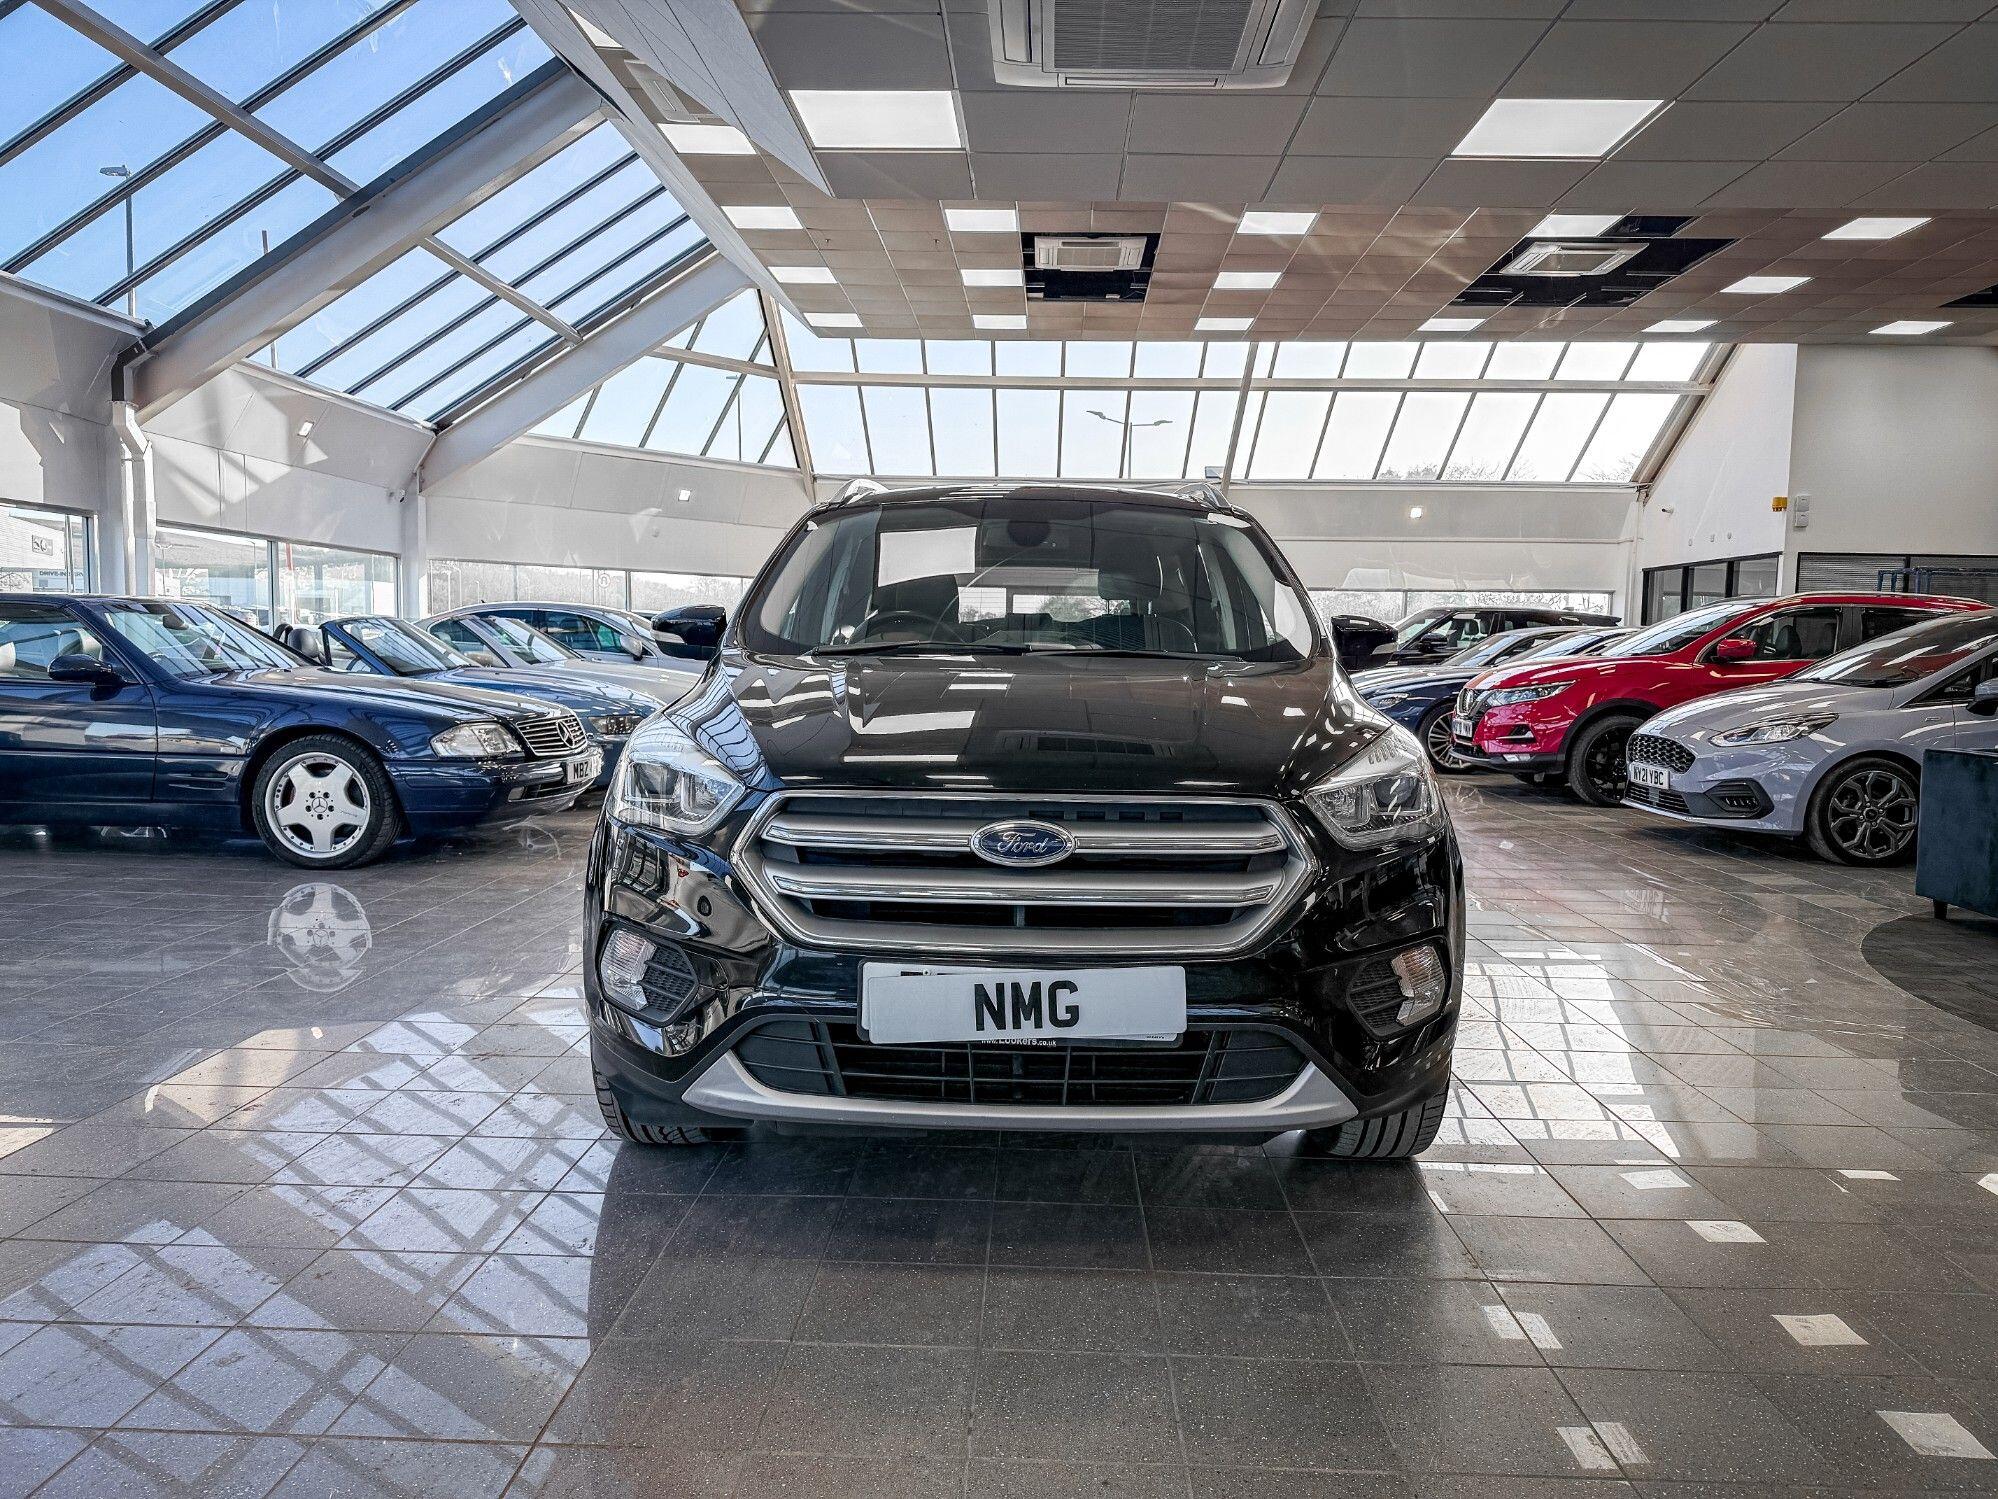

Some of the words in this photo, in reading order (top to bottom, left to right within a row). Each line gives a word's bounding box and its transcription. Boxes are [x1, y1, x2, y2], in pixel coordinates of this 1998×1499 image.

[1649, 769, 1664, 785] YBC
[997, 831, 1049, 853] Ford
[973, 980, 1080, 1031] NMG
